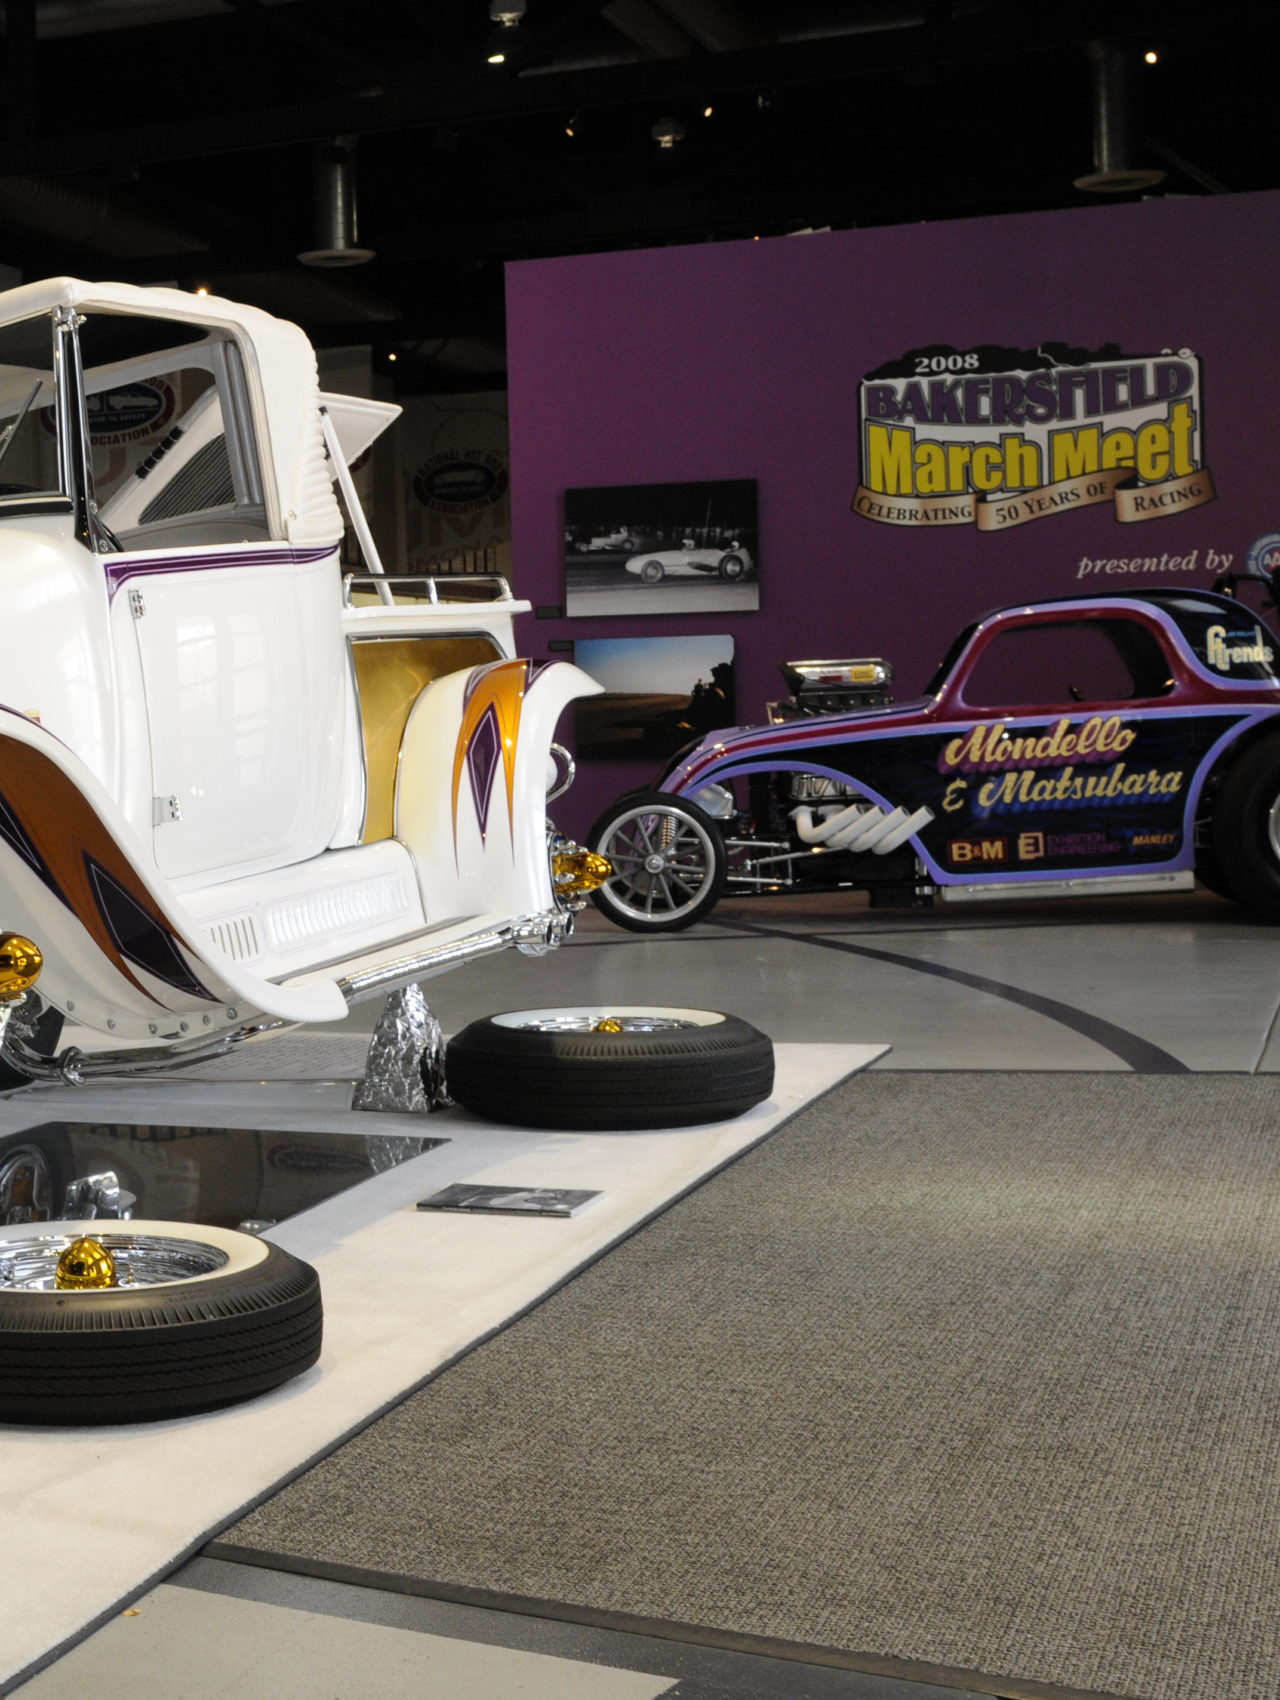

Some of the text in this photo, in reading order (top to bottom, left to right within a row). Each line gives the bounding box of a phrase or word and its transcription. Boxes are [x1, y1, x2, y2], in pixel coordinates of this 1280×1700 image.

[914, 353, 980, 373] 2008
[865, 360, 1194, 426] BAKERSFIELD
[91, 425, 150, 446] OCIATION
[867, 400, 1195, 496] March Meet
[995, 504, 1020, 525] 50
[1023, 487, 1081, 516] YEARS
[1086, 481, 1109, 498] OF
[1133, 482, 1203, 513] RACING
[1076, 549, 1199, 579] presented
[1205, 549, 1234, 574] by
[943, 715, 1137, 766] Mondello
[941, 762, 1184, 812] & Matsubara
[951, 841, 1004, 862] B&M
[1132, 834, 1175, 846] MANLEY
